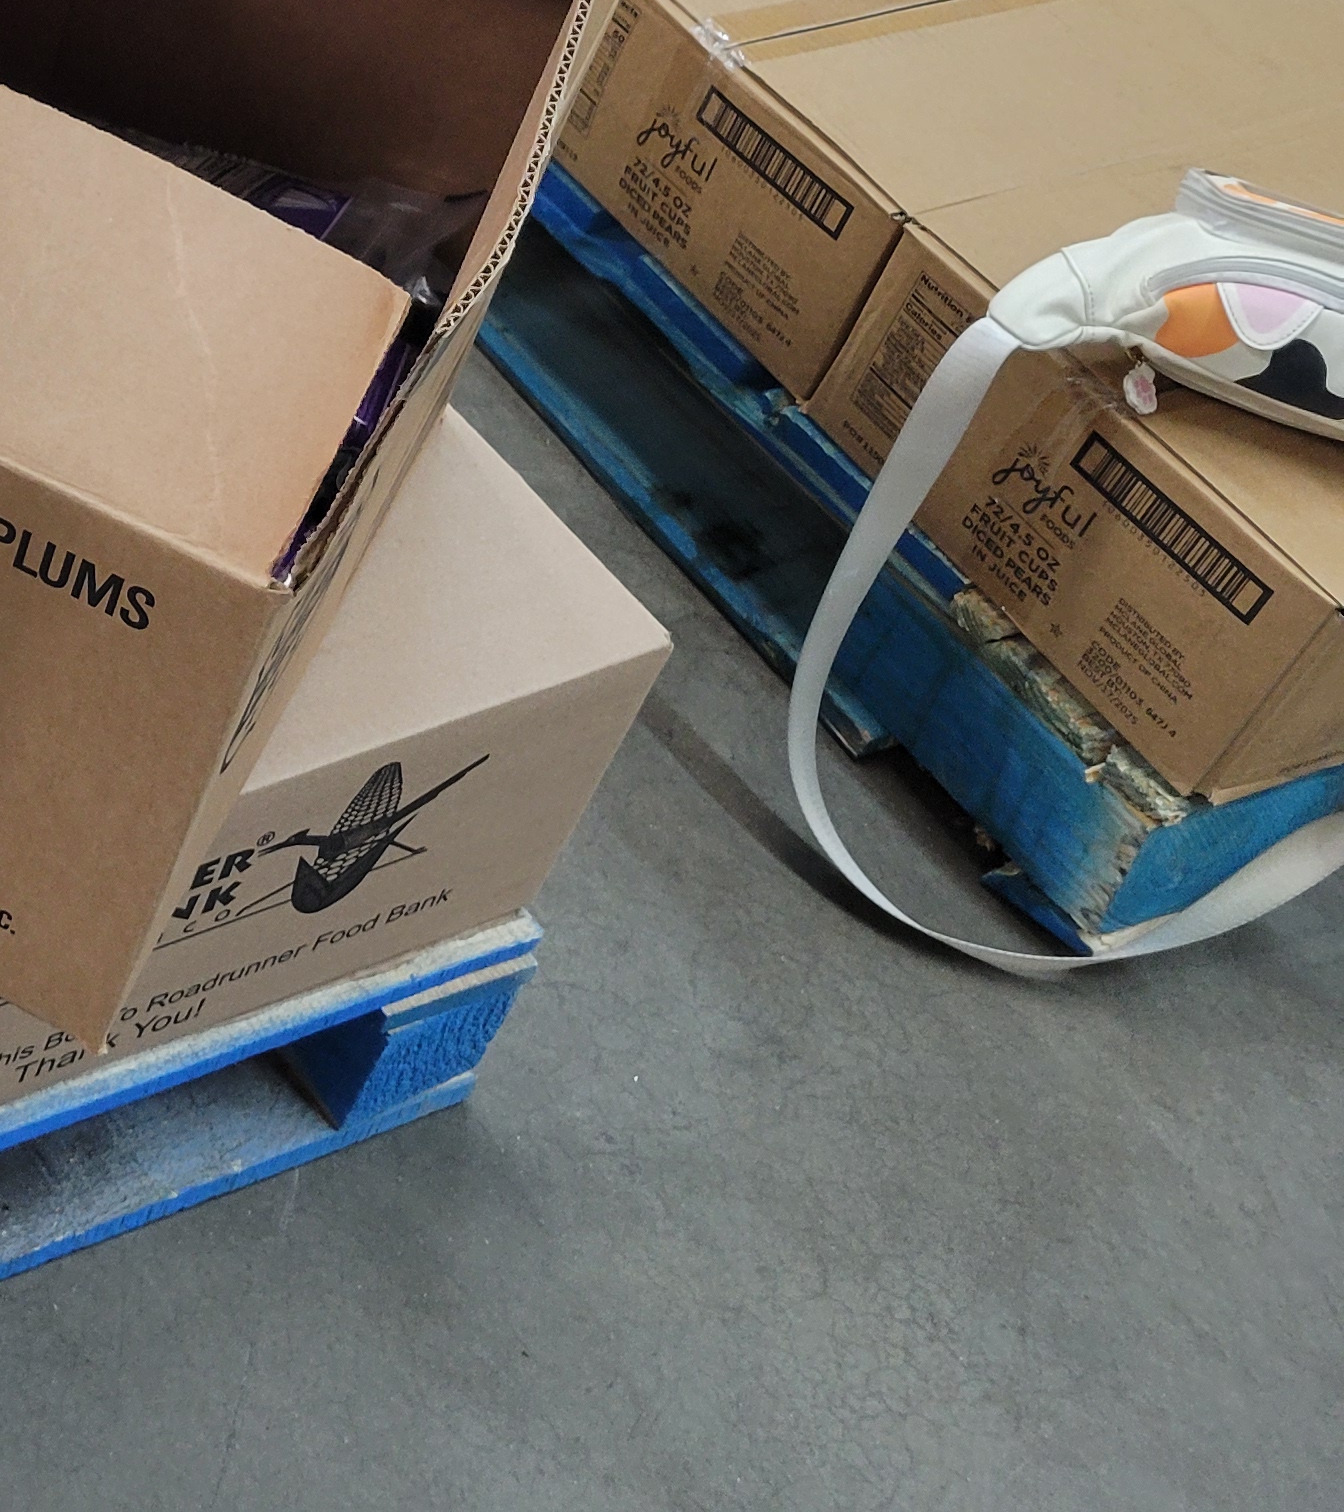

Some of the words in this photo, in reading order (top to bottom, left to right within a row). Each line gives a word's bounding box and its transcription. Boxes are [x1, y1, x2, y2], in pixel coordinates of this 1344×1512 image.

[637, 115, 718, 184] joyful
[617, 177, 650, 213] DICED
[650, 209, 688, 250] PEARS
[622, 165, 657, 202] FRUIT
[659, 200, 692, 235] CUPS
[632, 156, 671, 198] 72/4.5
[671, 194, 692, 218] OZ
[639, 215, 670, 249] JUICE
[903, 302, 944, 340] Calories
[919, 274, 965, 318] Nutrition
[992, 454, 1098, 538] joyful
[961, 515, 1005, 561] DICED
[1004, 557, 1052, 606] PEARS
[969, 503, 1015, 549] FRUIT
[1016, 549, 1059, 592] CUPS
[983, 495, 1036, 549] 72/4.5
[1035, 545, 1060, 573] OZ
[1038, 512, 1076, 551] FOODS
[970, 544, 986, 562] IN
[988, 562, 1027, 602] JUICE
[1118, 597, 1172, 649] DISTRIBUTED
[1148, 636, 1183, 671] GLOBAL
[1089, 639, 1120, 671] CODE
[1099, 626, 1137, 664] PRODUCT
[1150, 675, 1179, 704] CHINA
[147, 943, 308, 1012] Roadrunner
[312, 914, 380, 950] Food
[385, 888, 453, 925] Bank
[134, 999, 205, 1038] You!
